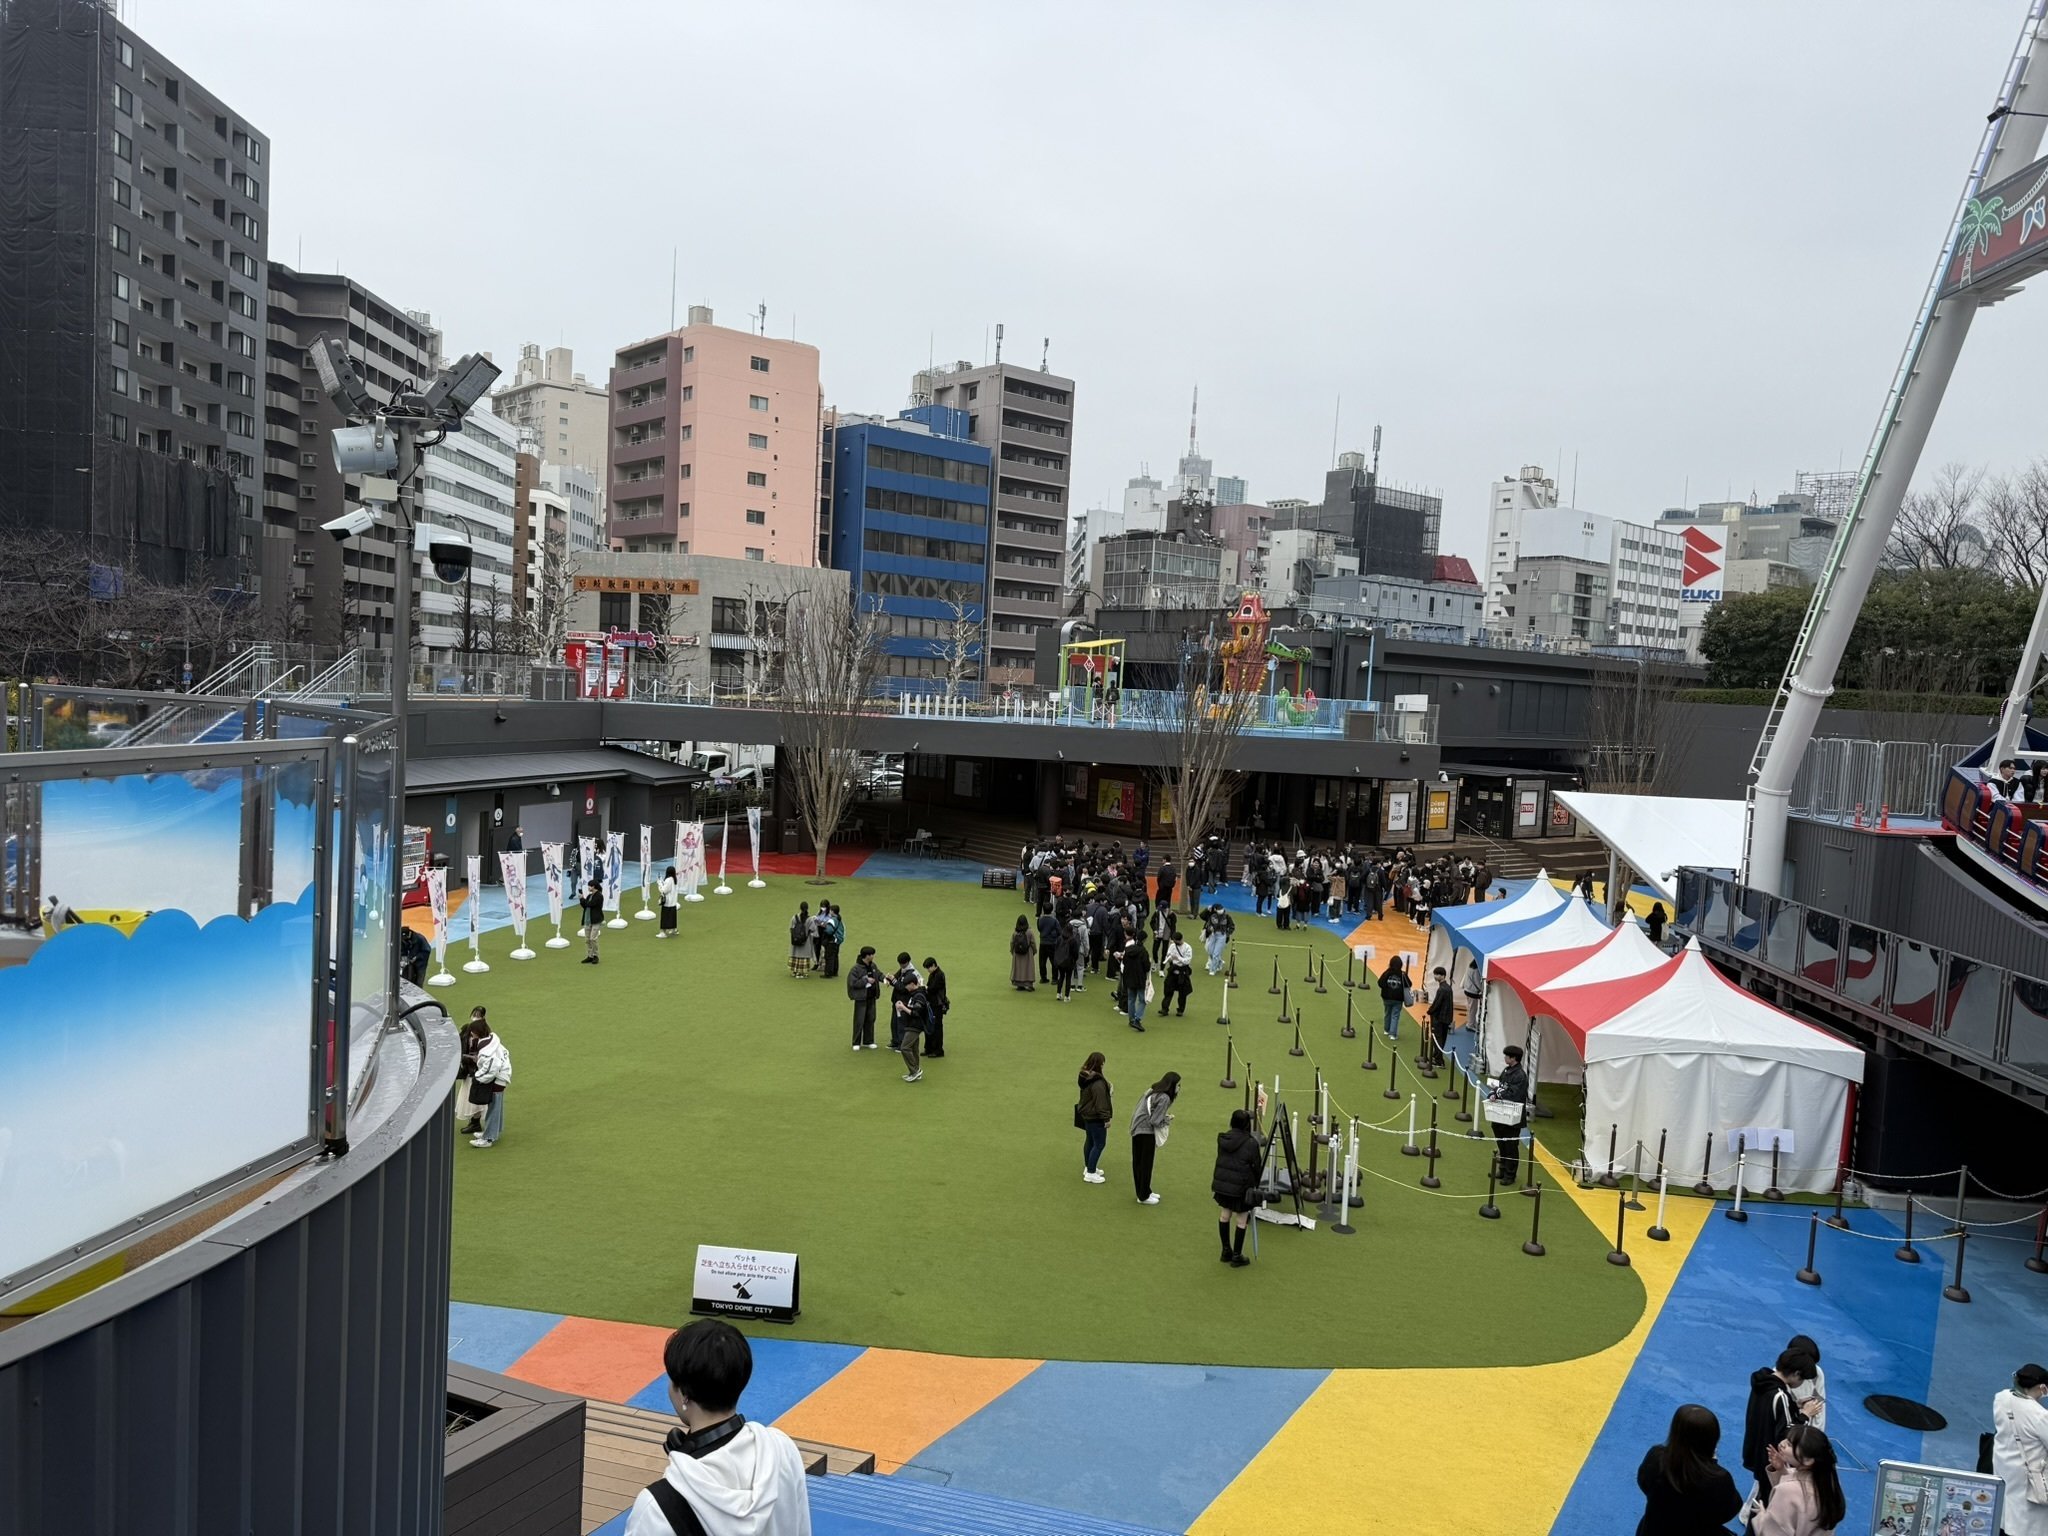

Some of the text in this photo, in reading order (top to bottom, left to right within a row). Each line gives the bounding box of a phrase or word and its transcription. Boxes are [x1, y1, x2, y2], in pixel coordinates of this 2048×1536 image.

[711, 1302, 773, 1314] TOKYO DOME CITY
